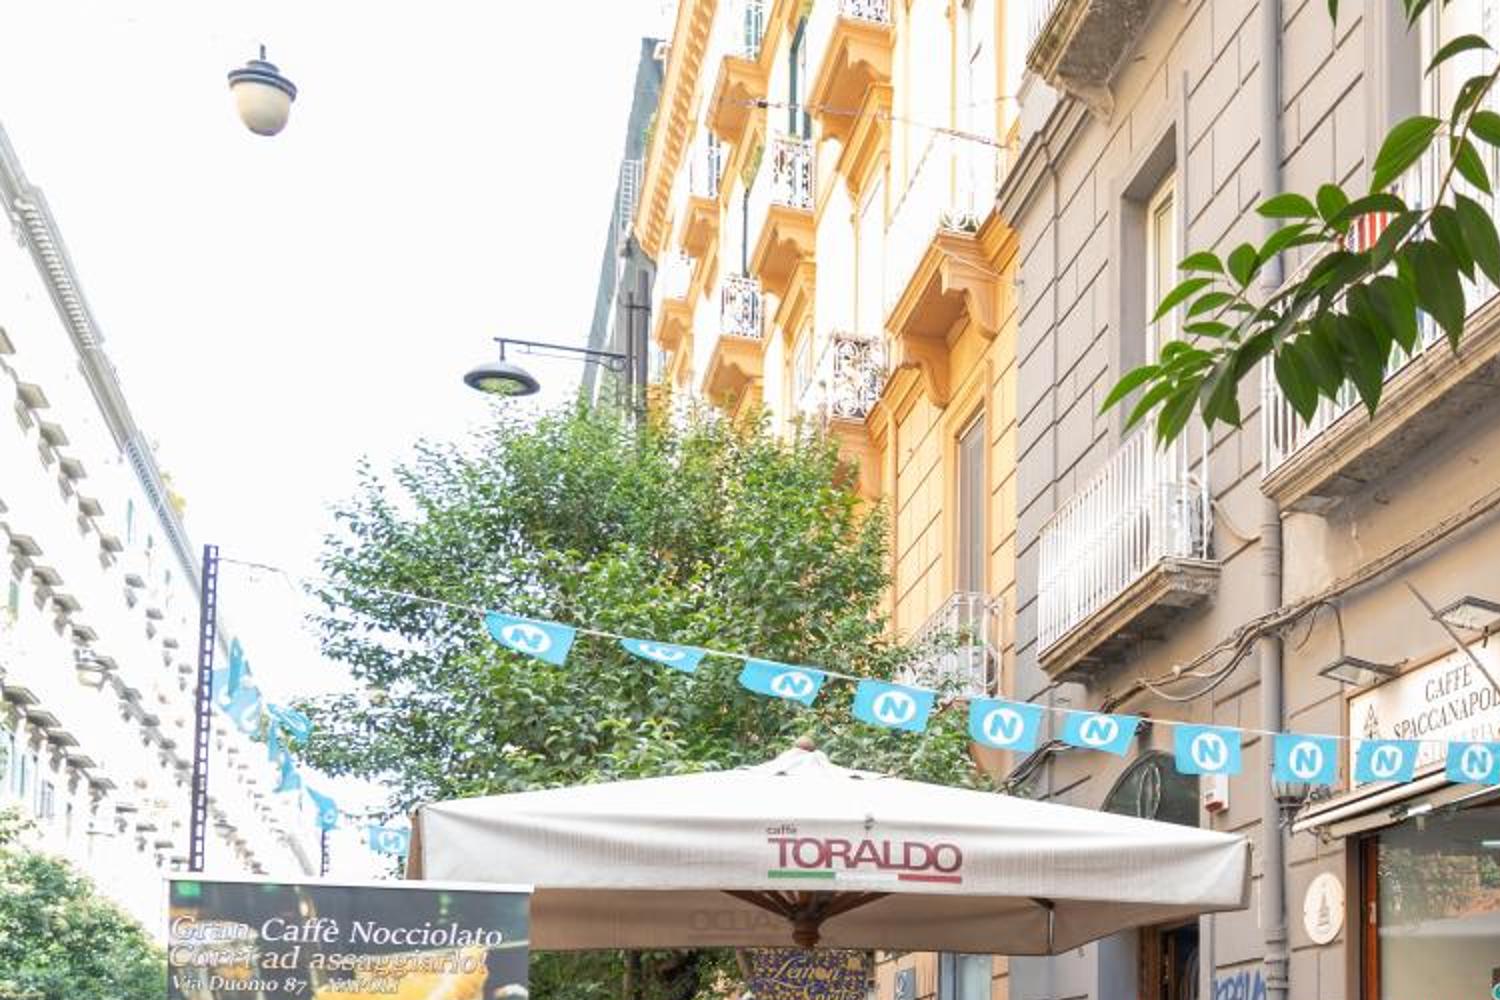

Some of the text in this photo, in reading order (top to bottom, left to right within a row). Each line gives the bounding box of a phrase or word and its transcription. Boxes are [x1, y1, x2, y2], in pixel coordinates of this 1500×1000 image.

[768, 837, 963, 873] TORALDO
[260, 917, 340, 943] Caffè
[349, 921, 504, 947] Nocciolato
[261, 945, 301, 970] ad
[172, 974, 203, 992] Via
[208, 975, 279, 992] Duomo
[283, 975, 307, 996] 87
